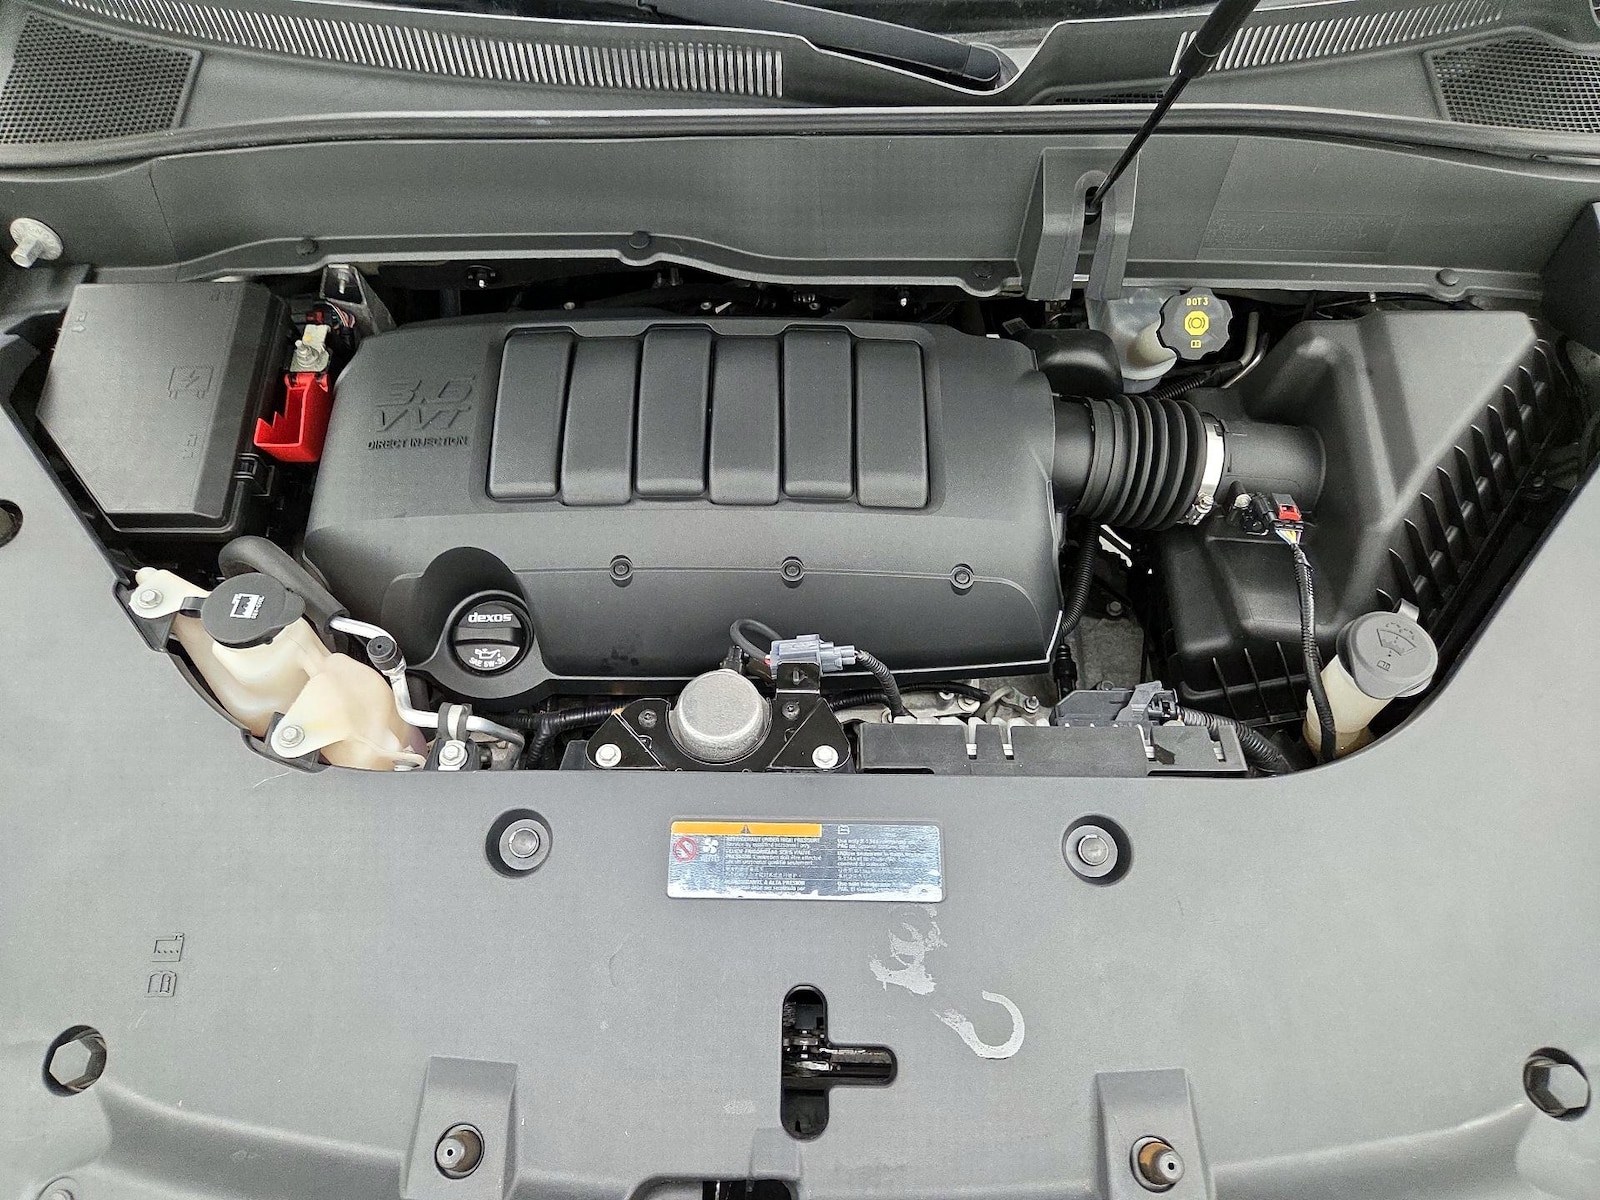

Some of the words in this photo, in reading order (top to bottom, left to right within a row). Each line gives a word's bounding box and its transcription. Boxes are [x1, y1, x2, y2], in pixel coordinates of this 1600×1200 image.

[1186, 297, 1202, 306] DOT
[1202, 297, 1209, 306] 3
[376, 374, 476, 408] 3.6
[375, 405, 472, 433] VVT
[367, 438, 408, 450] DIRECT
[410, 436, 468, 449] INJECTION
[467, 612, 514, 623] dexos
[469, 657, 483, 667] SAE
